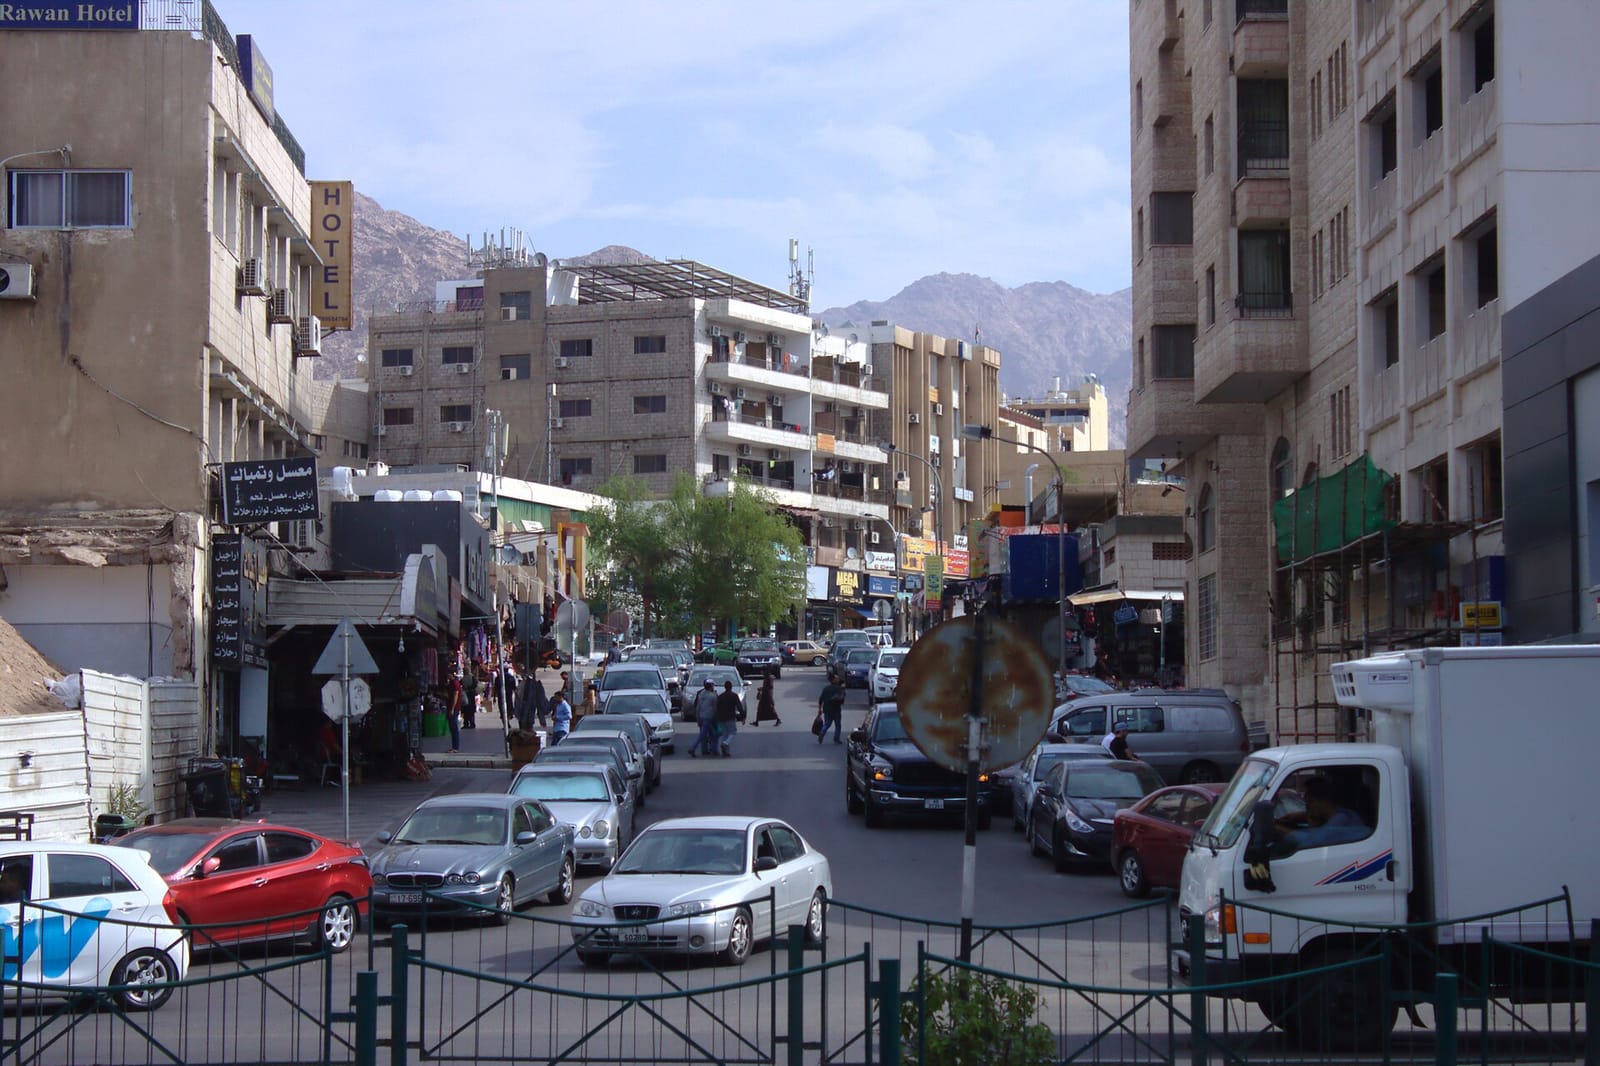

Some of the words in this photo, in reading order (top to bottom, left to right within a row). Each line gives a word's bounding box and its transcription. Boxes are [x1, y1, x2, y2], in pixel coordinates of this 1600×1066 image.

[0, 4, 69, 21] Rawan
[77, 4, 132, 21] Hotel
[322, 188, 341, 309] HOTEL
[276, 464, 312, 482] معسل
